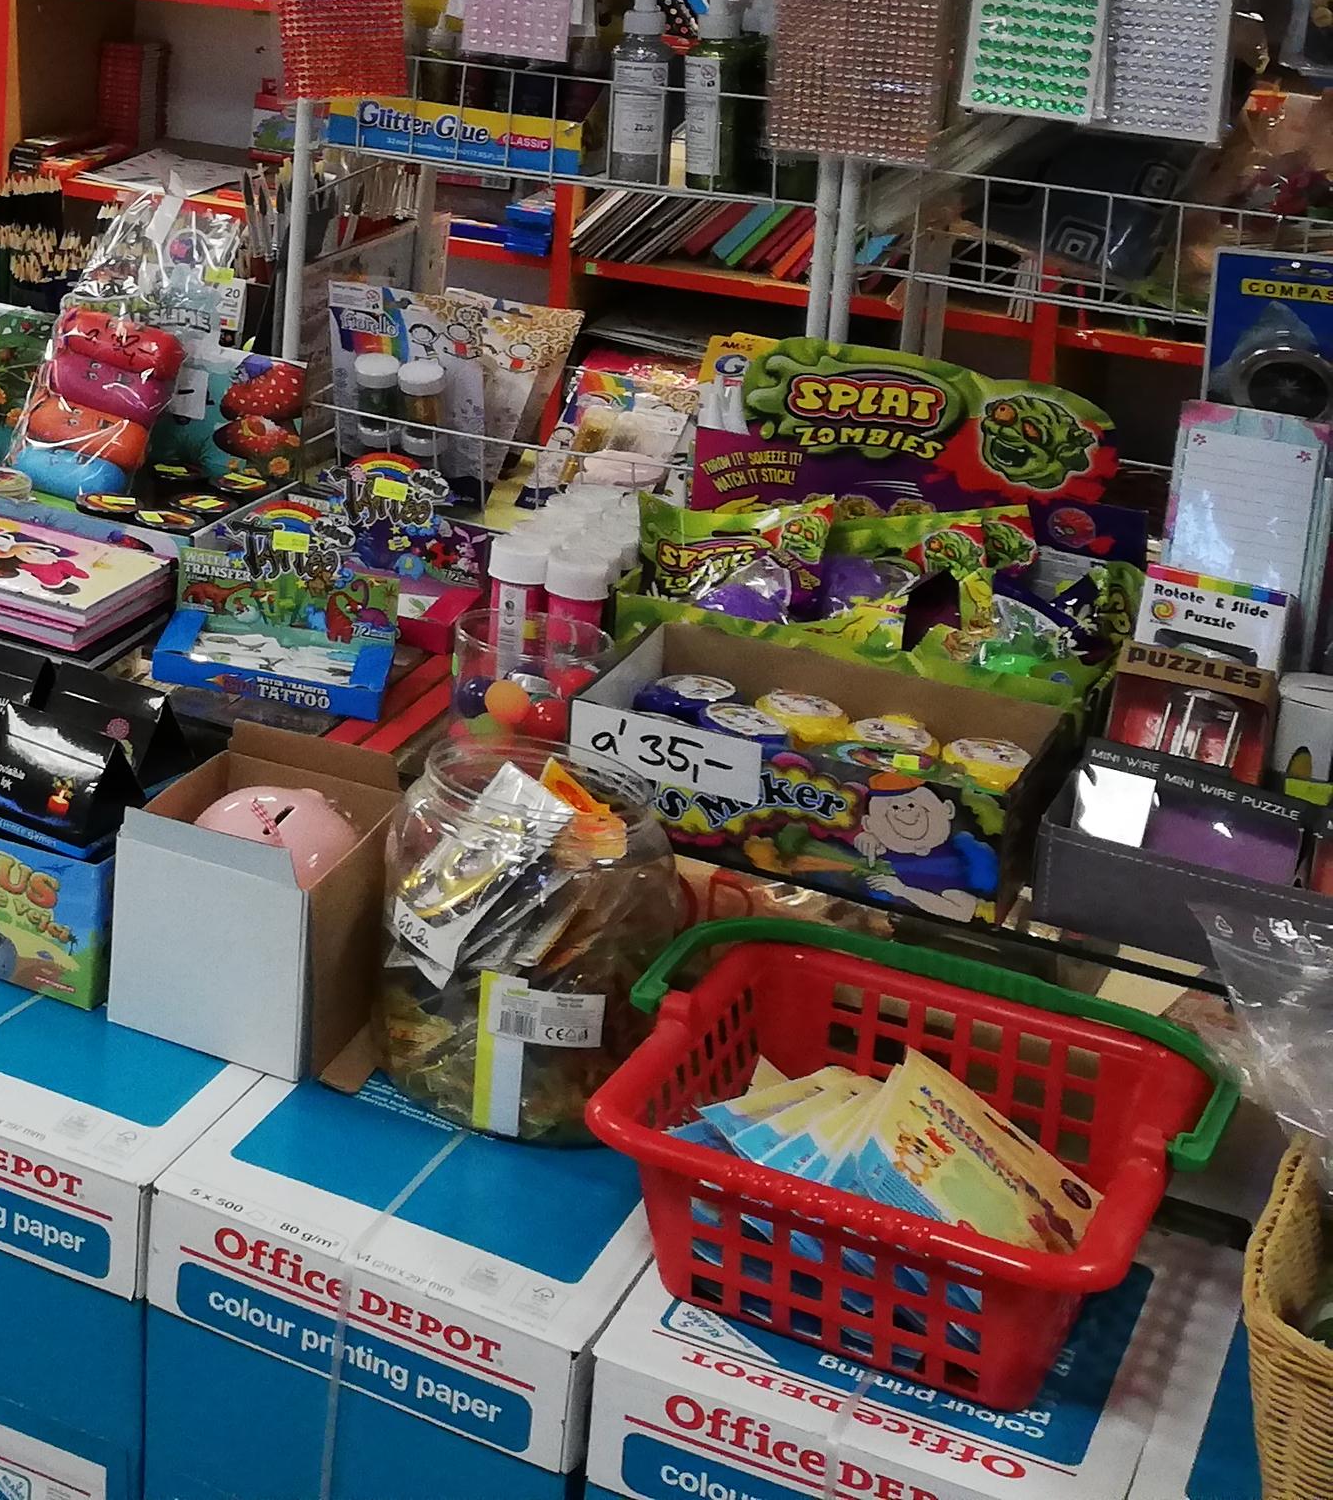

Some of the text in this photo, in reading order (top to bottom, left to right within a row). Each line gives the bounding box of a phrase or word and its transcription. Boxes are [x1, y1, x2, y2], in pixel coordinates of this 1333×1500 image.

[357, 99, 432, 137] Glitter
[434, 113, 490, 145] Glue
[501, 133, 552, 151] CLASSIC
[340, 308, 400, 338] Fiorello
[794, 381, 937, 421] SPLAT
[794, 425, 946, 461] ZOMBIES
[699, 454, 731, 477] THROW
[748, 451, 788, 467] SQUEEZE
[787, 451, 804, 467] IT!
[712, 468, 796, 494] WATCH IT STICK!
[184, 561, 253, 583] TRANSFER
[351, 621, 371, 638] 72
[1184, 608, 1237, 631] Puzzle
[1231, 601, 1271, 620] Slide
[1127, 645, 1265, 690] PUZZLES
[258, 685, 331, 711] TATTOO
[1091, 747, 1161, 774] MINI WIRE
[1164, 772, 1301, 821] MINI WIRE PUZZLE
[13, 1208, 87, 1255] paper
[215, 1196, 299, 1236] 500 80
[214, 1226, 343, 1300] Office
[358, 1288, 502, 1363] DEPOT
[208, 1290, 504, 1426] colour printing paper
[681, 1349, 1027, 1480] Office DEPOT
[942, 1397, 1046, 1440] colour
[664, 1394, 827, 1477] Office
